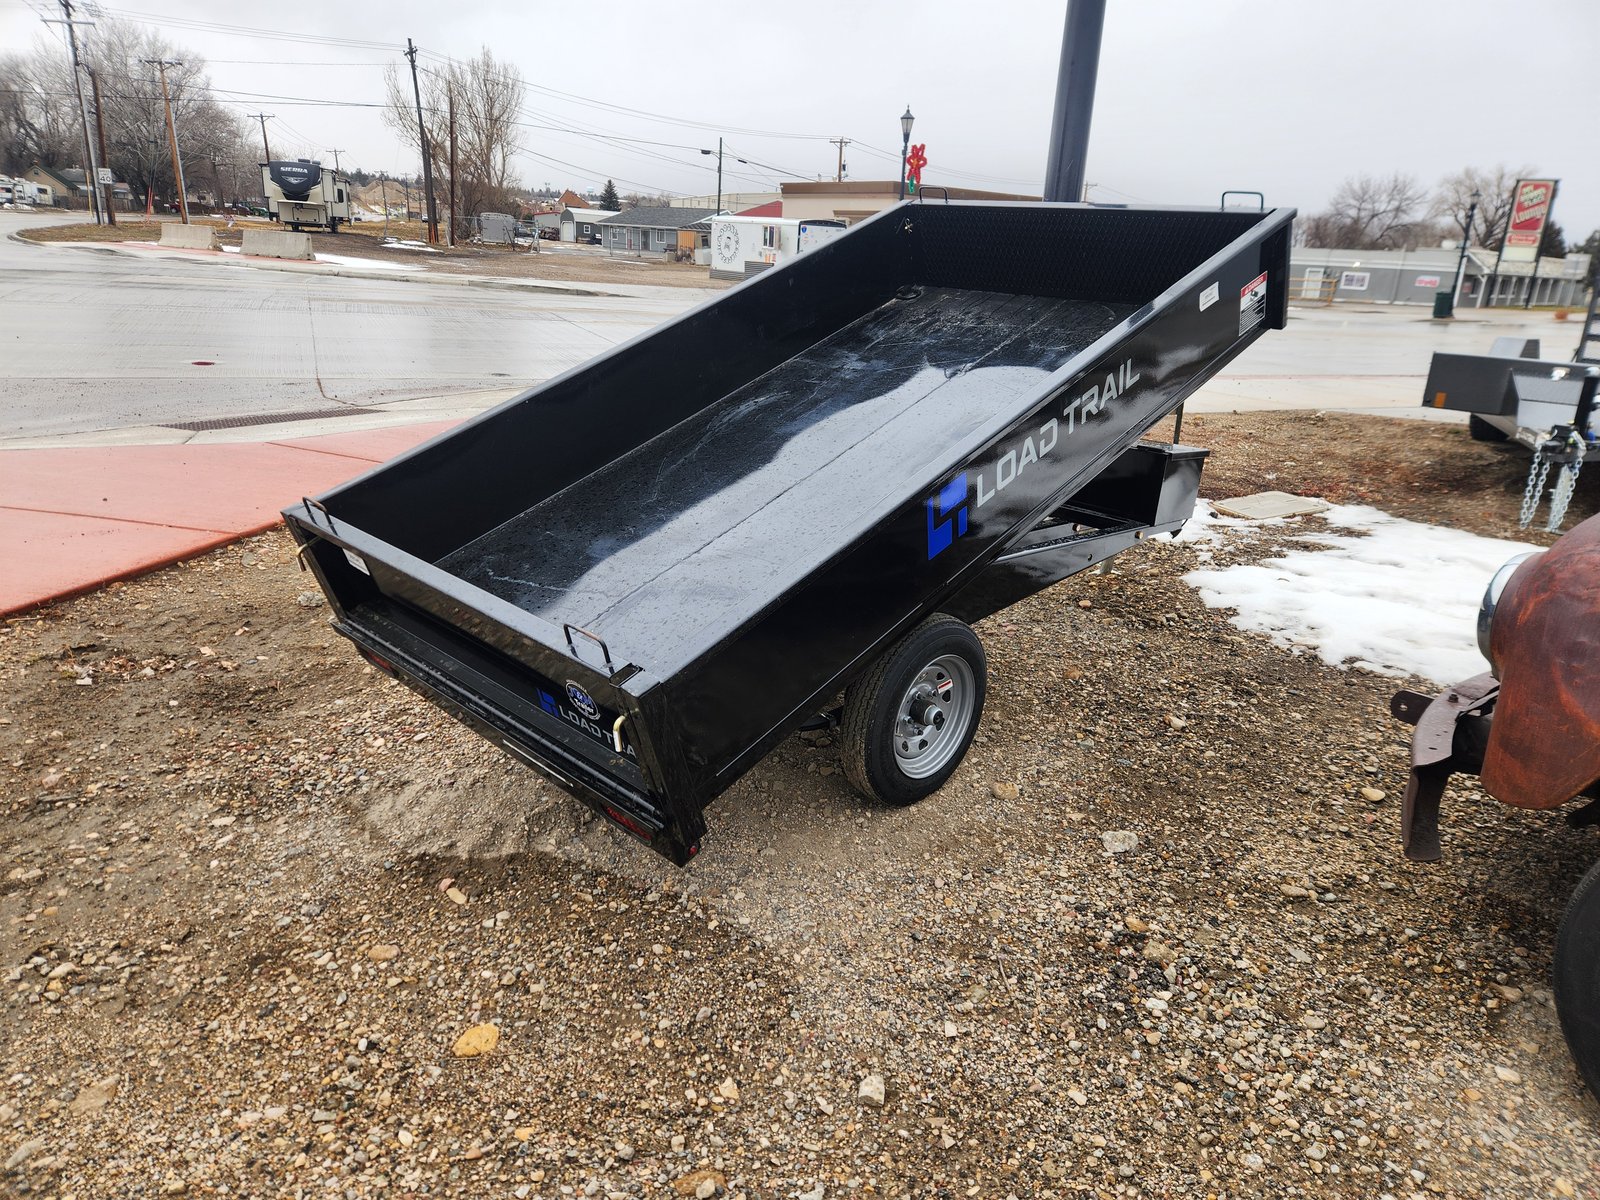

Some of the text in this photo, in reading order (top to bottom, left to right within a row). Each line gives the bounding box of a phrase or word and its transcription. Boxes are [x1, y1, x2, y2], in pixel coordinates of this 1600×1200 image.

[280, 166, 308, 174] SIERRA
[977, 358, 1140, 508] LOAD TRAIL
[559, 704, 602, 738] LOAD
